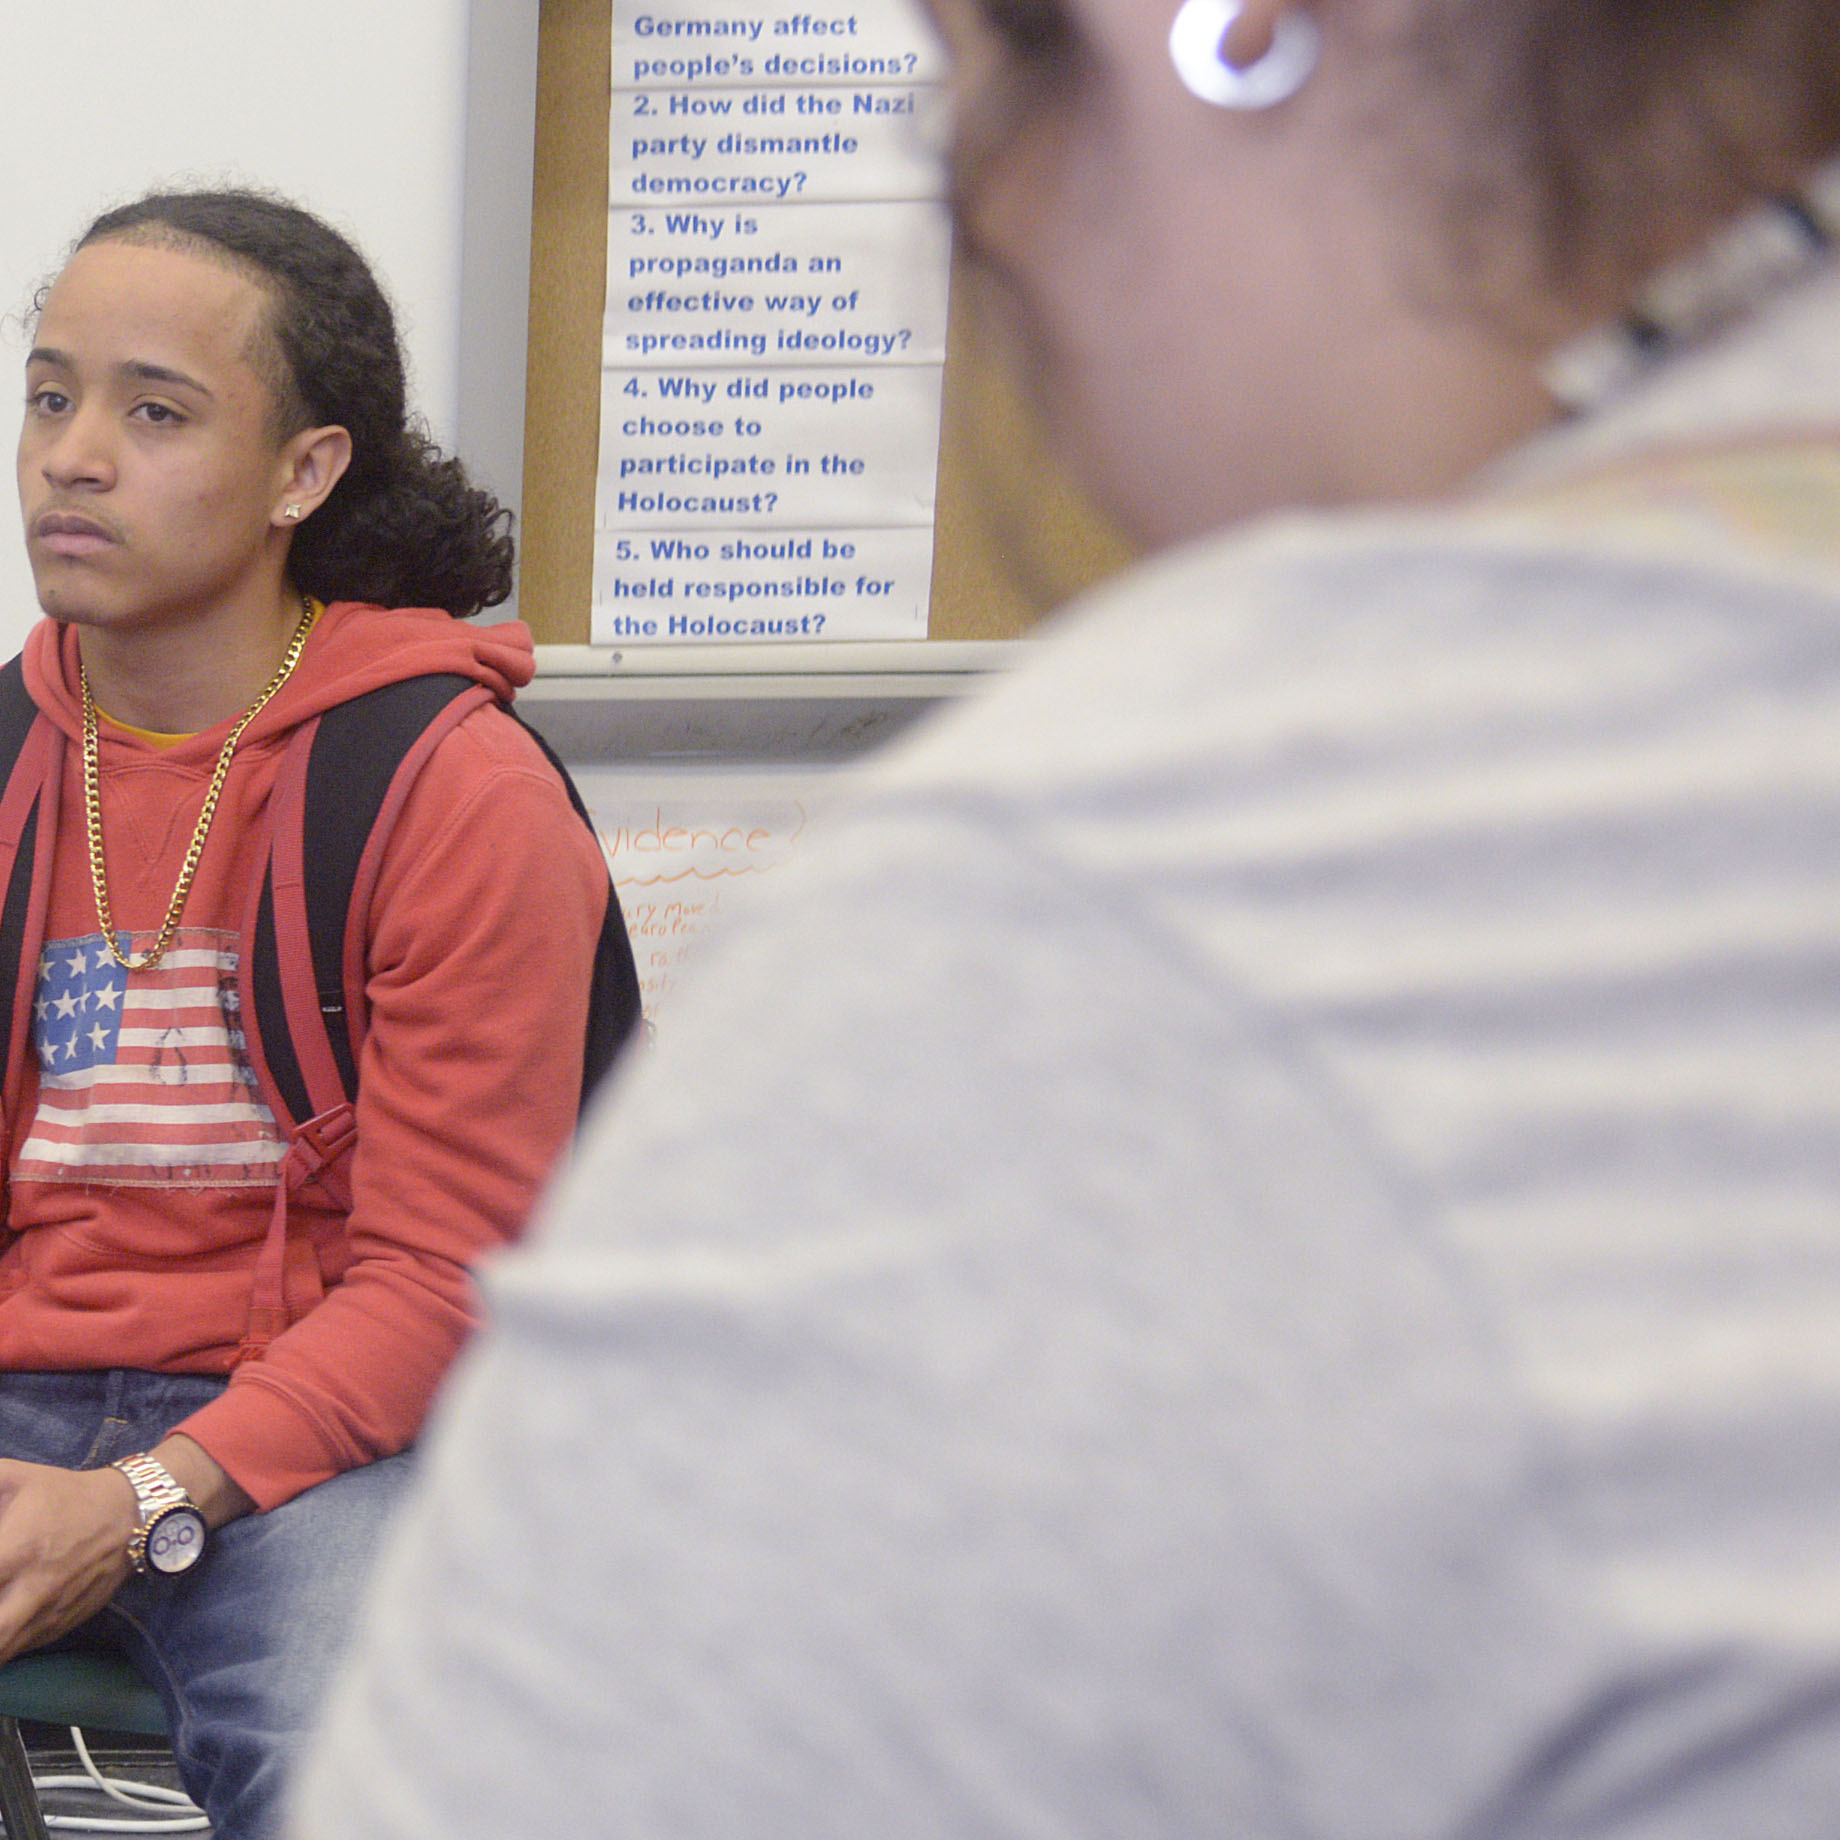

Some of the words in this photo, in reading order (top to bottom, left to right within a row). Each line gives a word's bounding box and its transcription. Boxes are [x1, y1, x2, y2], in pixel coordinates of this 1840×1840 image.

[634, 15, 762, 40] Germany
[774, 15, 856, 35] affect
[765, 54, 917, 74] decisions?
[634, 94, 657, 116] 2.
[670, 95, 732, 115] How
[743, 95, 785, 114] did
[797, 95, 841, 114] the
[854, 92, 919, 118] Nazi
[633, 136, 706, 159] party
[717, 133, 857, 153] dismantle
[632, 172, 806, 198] democracy?
[632, 214, 654, 234] 3.
[666, 215, 724, 239] Why
[736, 214, 757, 234] is
[630, 253, 797, 277] propaganda
[809, 258, 841, 272] an
[628, 292, 753, 311] effective
[765, 296, 821, 316] way
[832, 291, 858, 310] of
[626, 330, 766, 355] spreading
[778, 329, 912, 354] ideology?
[623, 378, 647, 397] 4.
[659, 378, 716, 403] Why
[727, 379, 768, 397] did
[780, 379, 873, 403] people
[623, 416, 723, 435] choose
[735, 418, 761, 435] to
[620, 455, 775, 479] participate
[786, 455, 809, 474] in
[821, 455, 864, 474] the
[618, 492, 777, 512] Holocaust?
[617, 540, 639, 560] 5.
[651, 540, 709, 559] Who
[721, 540, 811, 559] should
[823, 539, 855, 558] be
[614, 579, 673, 597] held
[684, 577, 845, 602] responsible
[856, 577, 894, 595] for
[614, 616, 657, 635] the
[669, 615, 825, 635] Holocaust?
[600, 807, 770, 858] vidence
